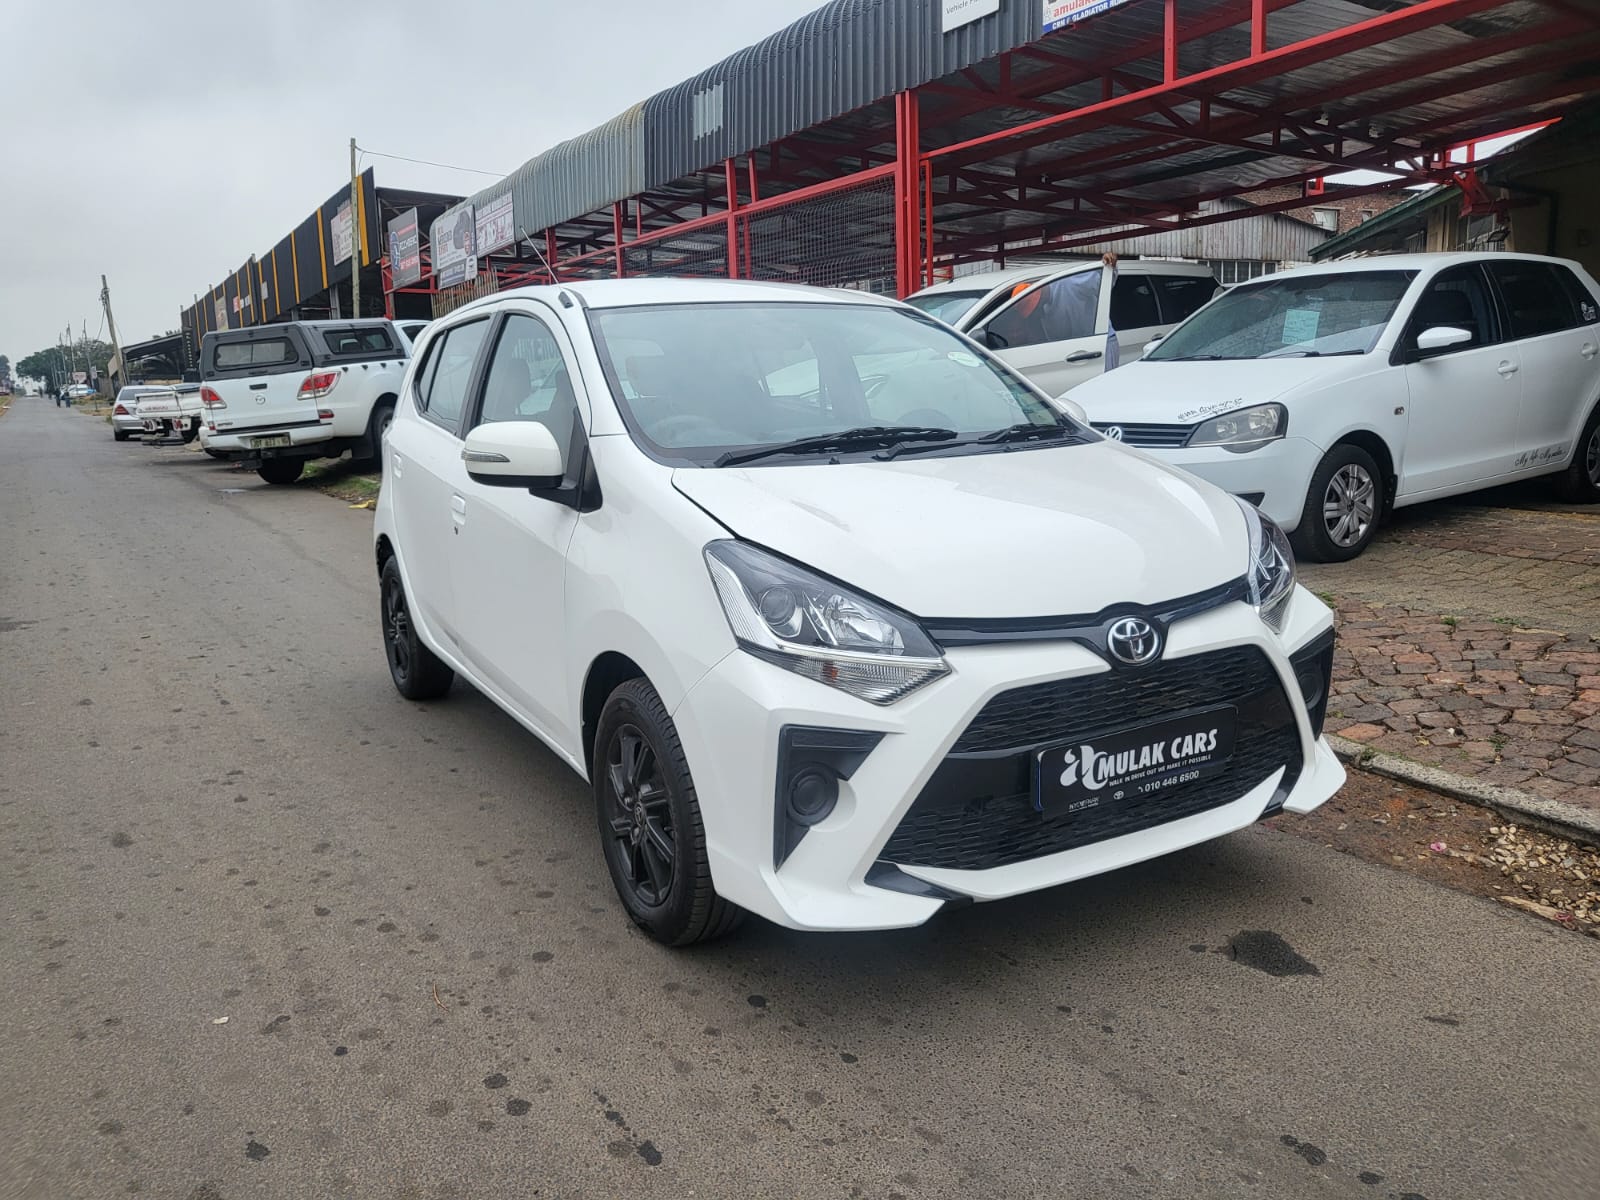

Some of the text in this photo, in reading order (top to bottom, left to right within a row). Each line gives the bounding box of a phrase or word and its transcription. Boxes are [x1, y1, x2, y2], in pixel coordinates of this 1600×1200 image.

[1171, 728, 1218, 759] CARS
[1131, 771, 1145, 781] DRIVE
[1147, 767, 1156, 776] OUT
[1166, 762, 1181, 771] MAKE
[1188, 754, 1212, 765] POSSIBLE
[1145, 782, 1161, 793] 010
[1179, 770, 1199, 782] 6500
